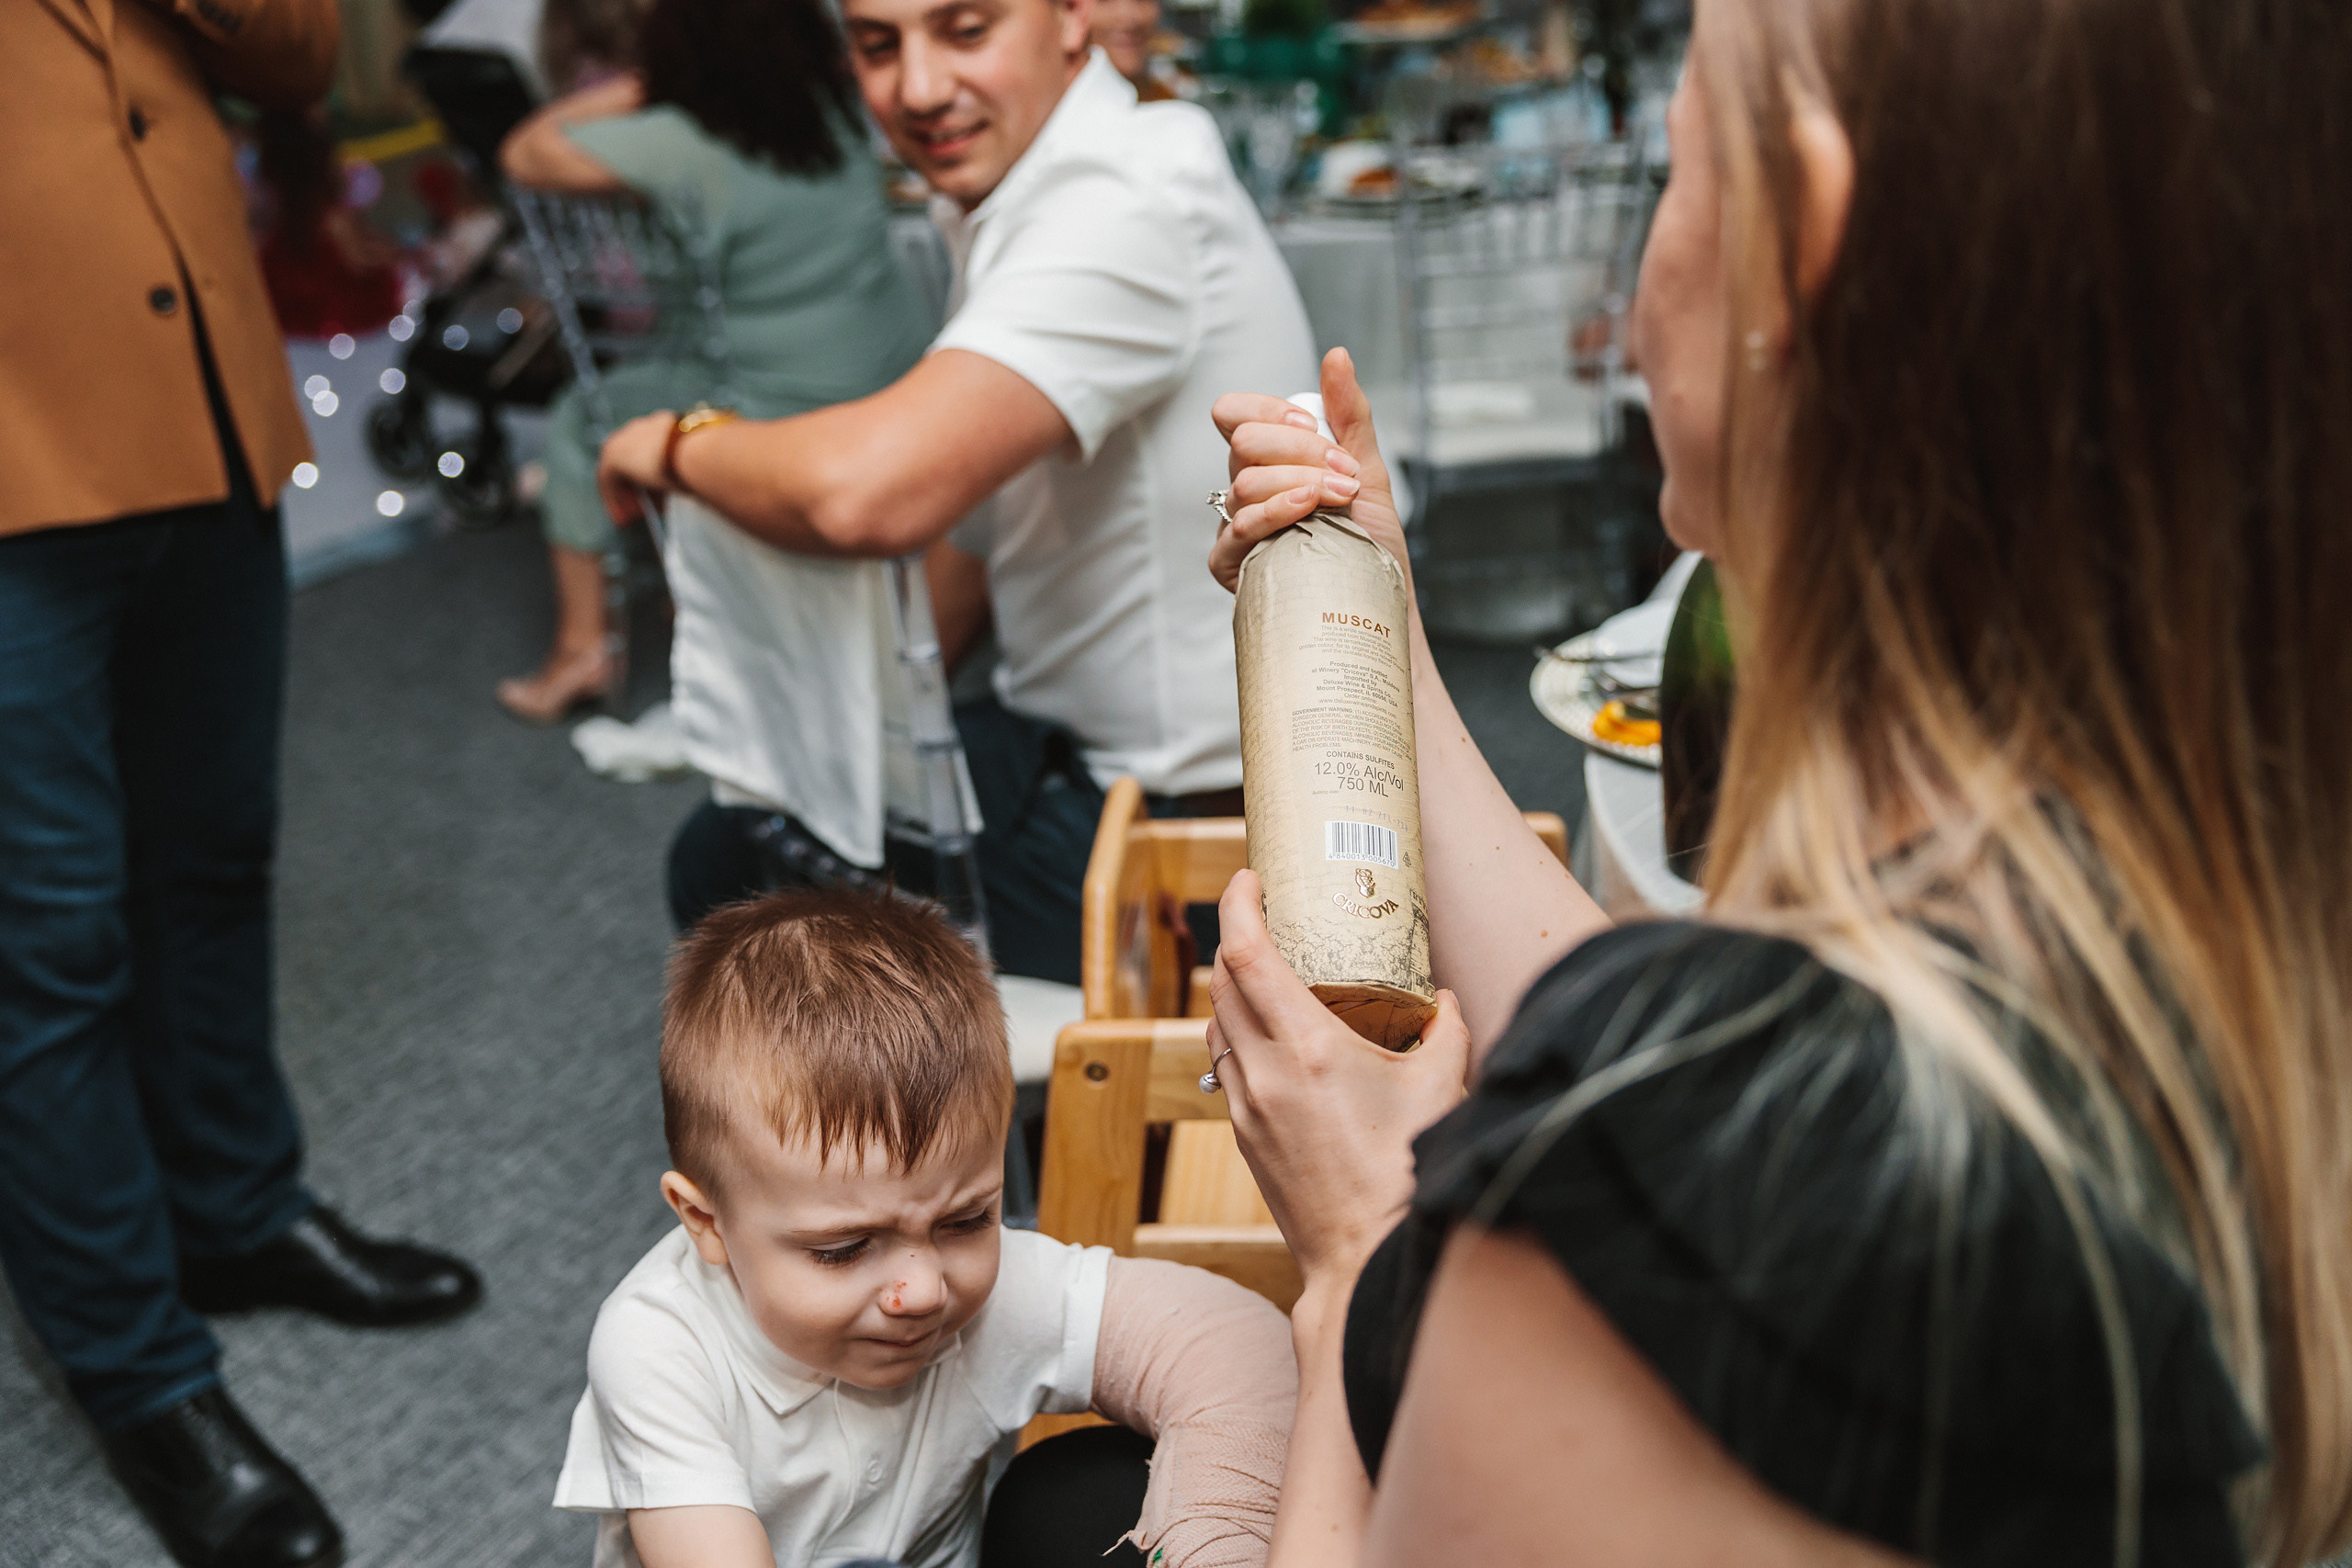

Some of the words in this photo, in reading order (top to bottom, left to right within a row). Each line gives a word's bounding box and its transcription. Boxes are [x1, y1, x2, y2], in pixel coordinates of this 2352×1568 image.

[1322, 613, 1391, 638] MUSCAT
[1341, 668, 1369, 677] "Cricova"
[1344, 675, 1369, 683] Imported
[1367, 684, 1384, 695] Spirits
[1388, 699, 1398, 708] USA
[1292, 707, 1328, 716] GOVERNMENT
[1326, 751, 1364, 760] CONTAINS
[1365, 755, 1395, 770] SULFITES
[1314, 761, 1360, 777] 12.0%
[1364, 765, 1404, 791] Alc/Vol
[1337, 776, 1364, 791] 750
[1369, 780, 1389, 798] ML
[1368, 855, 1395, 868] 005670
[1332, 891, 1399, 919] CRICOVA
